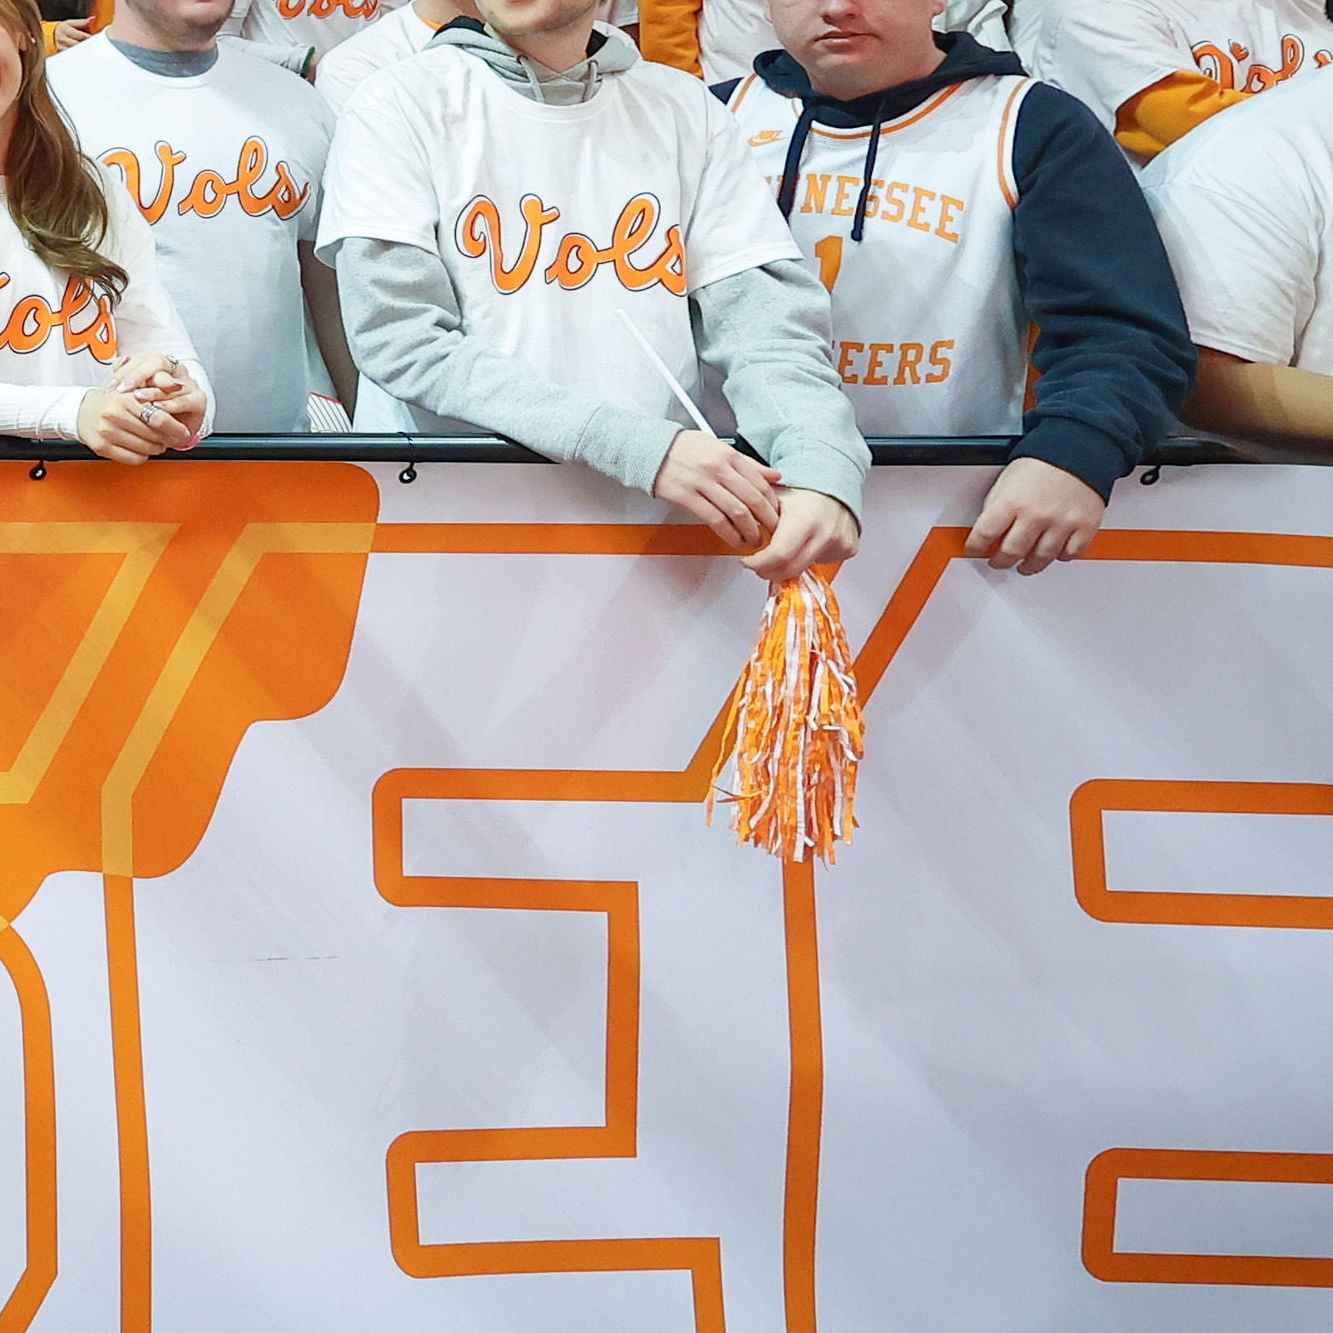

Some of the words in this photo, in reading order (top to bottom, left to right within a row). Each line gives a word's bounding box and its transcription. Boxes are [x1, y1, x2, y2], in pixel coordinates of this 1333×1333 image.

[99, 134, 311, 225] Vols
[766, 173, 965, 244] NESSEE
[454, 192, 689, 298] Vols
[831, 338, 956, 386] EERS
